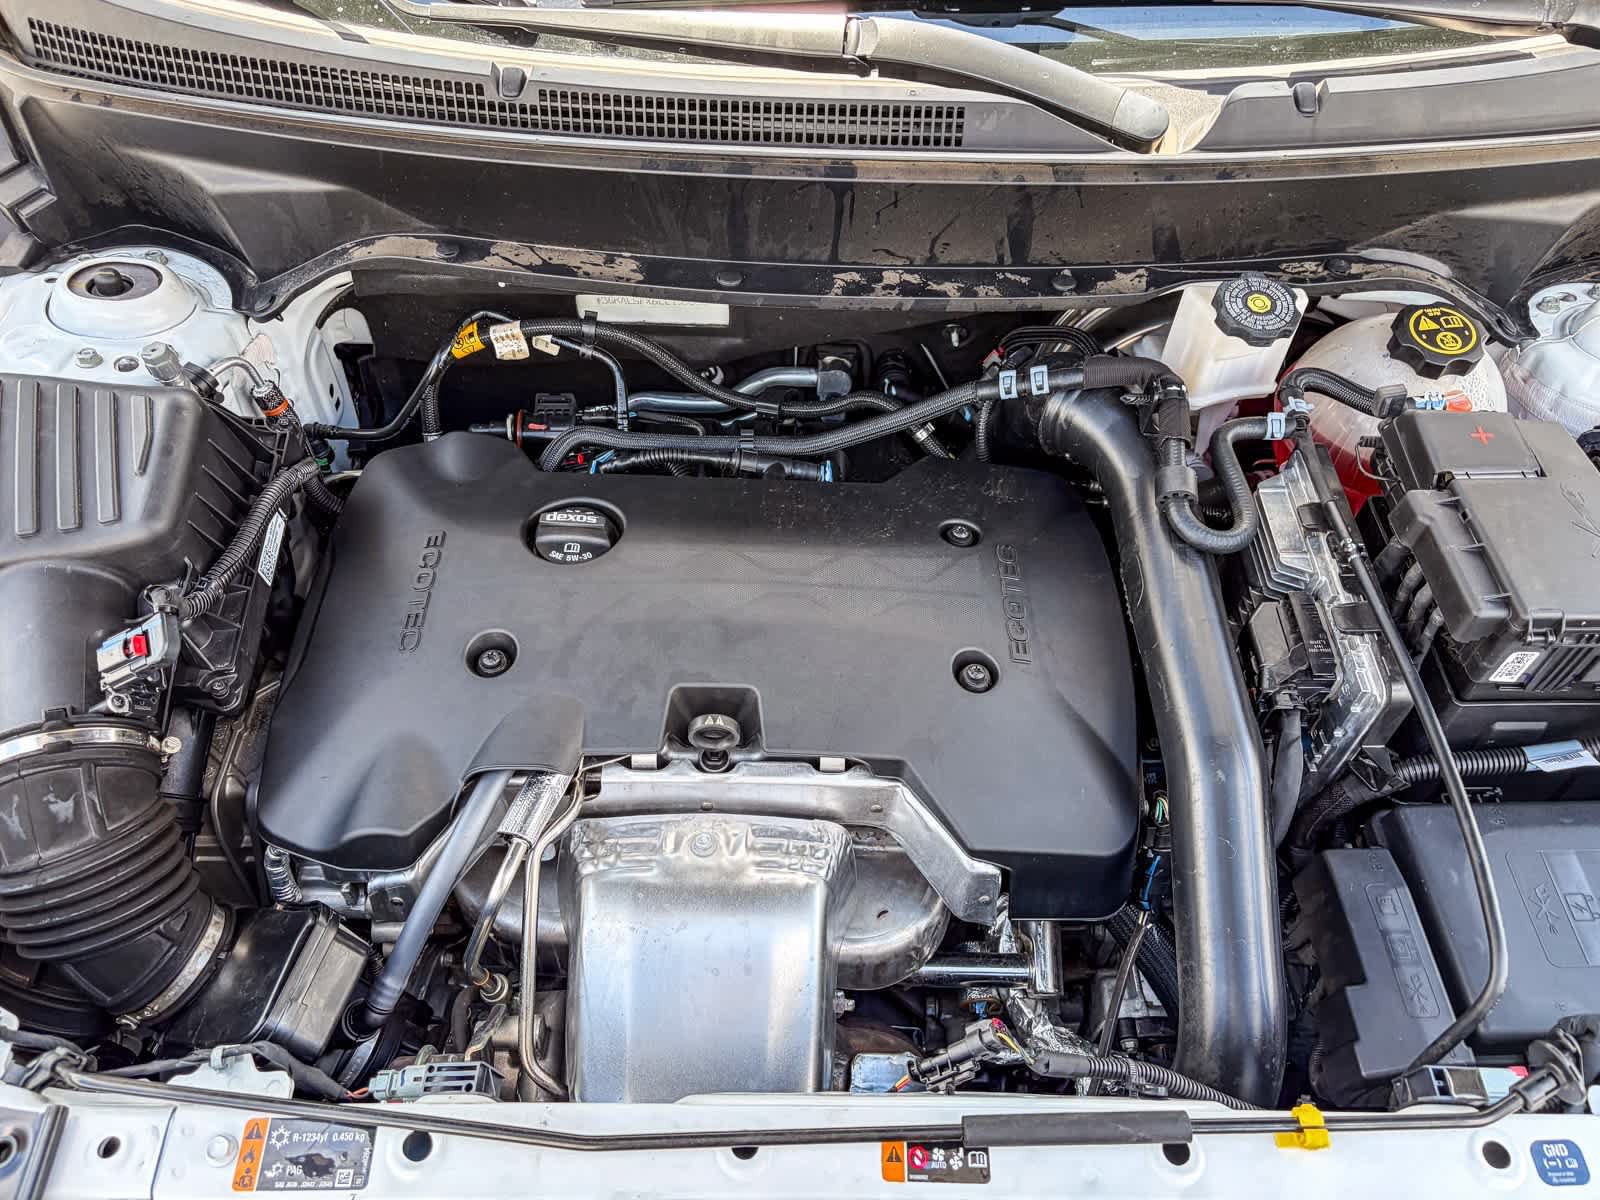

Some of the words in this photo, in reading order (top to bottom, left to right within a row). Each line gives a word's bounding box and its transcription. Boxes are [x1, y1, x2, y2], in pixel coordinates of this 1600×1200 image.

[545, 511, 599, 524] dexos
[549, 550, 565, 561] SAE
[566, 551, 593, 562] 5W-30
[400, 530, 447, 653] ECOTEC
[995, 543, 1033, 664] ECOTEC
[355, 1132, 366, 1143] kg
[1543, 1143, 1569, 1158] GND
[930, 1161, 947, 1169] AUTO
